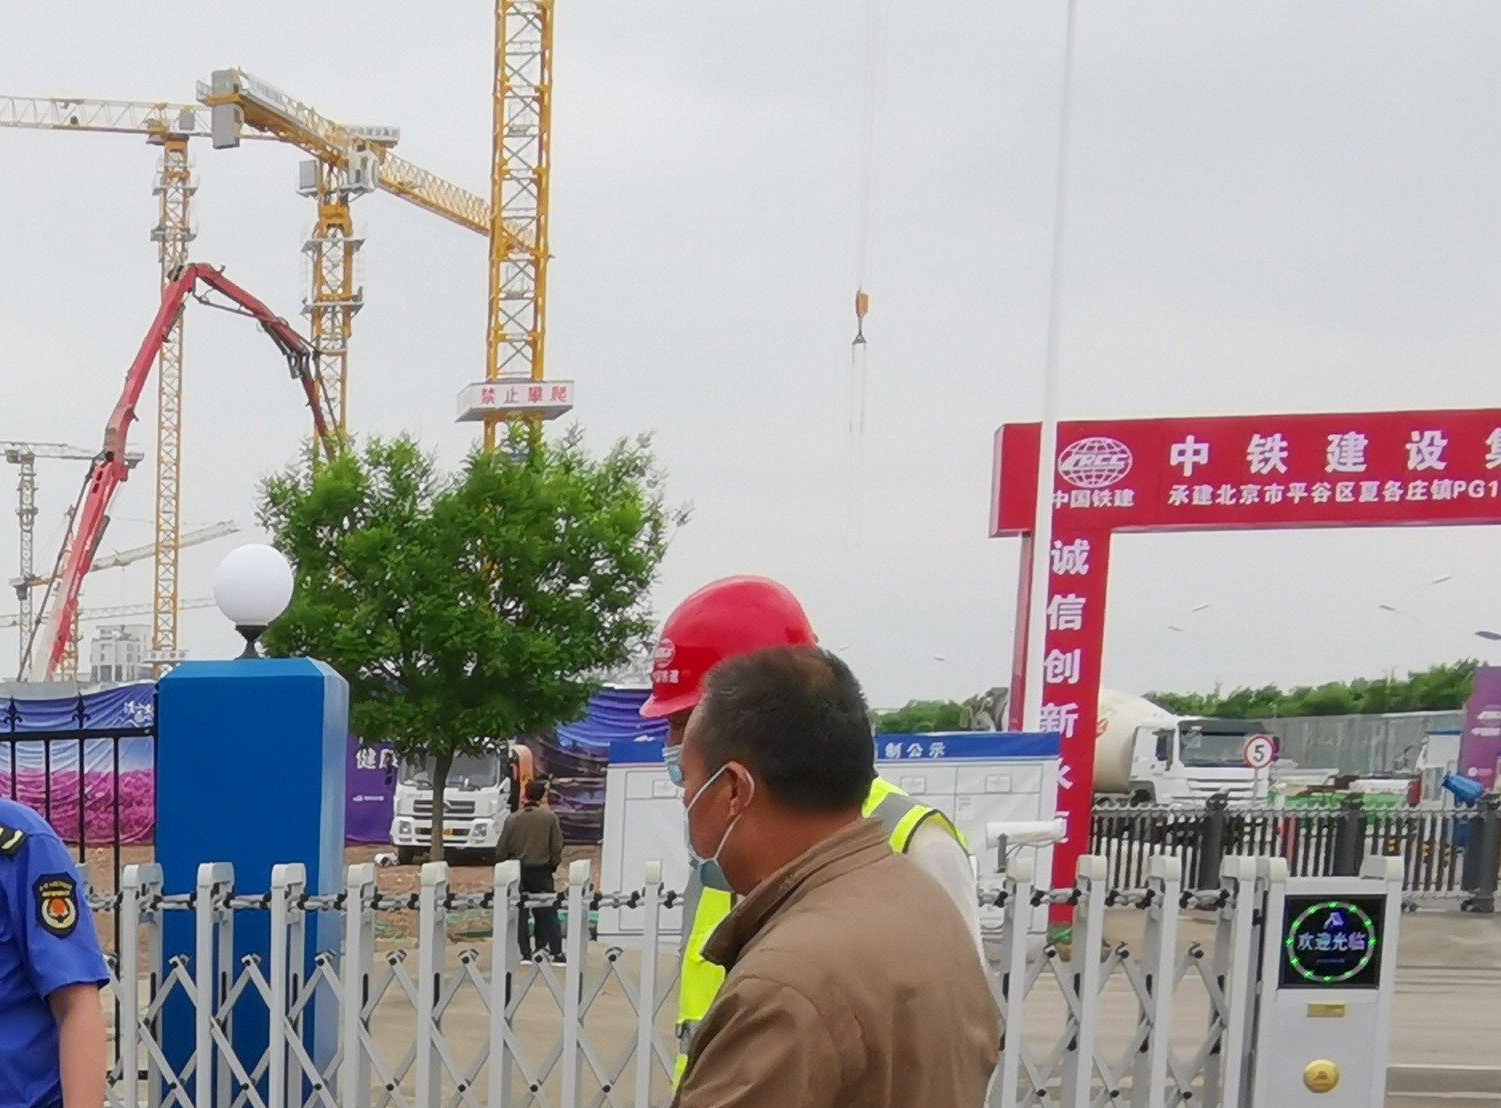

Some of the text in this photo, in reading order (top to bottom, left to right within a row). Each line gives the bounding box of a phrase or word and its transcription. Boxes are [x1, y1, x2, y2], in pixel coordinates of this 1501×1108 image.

[1053, 488, 1135, 509] 中国铁建
[1253, 744, 1265, 762] 5
[1297, 931, 1367, 951] 欢迎光临
